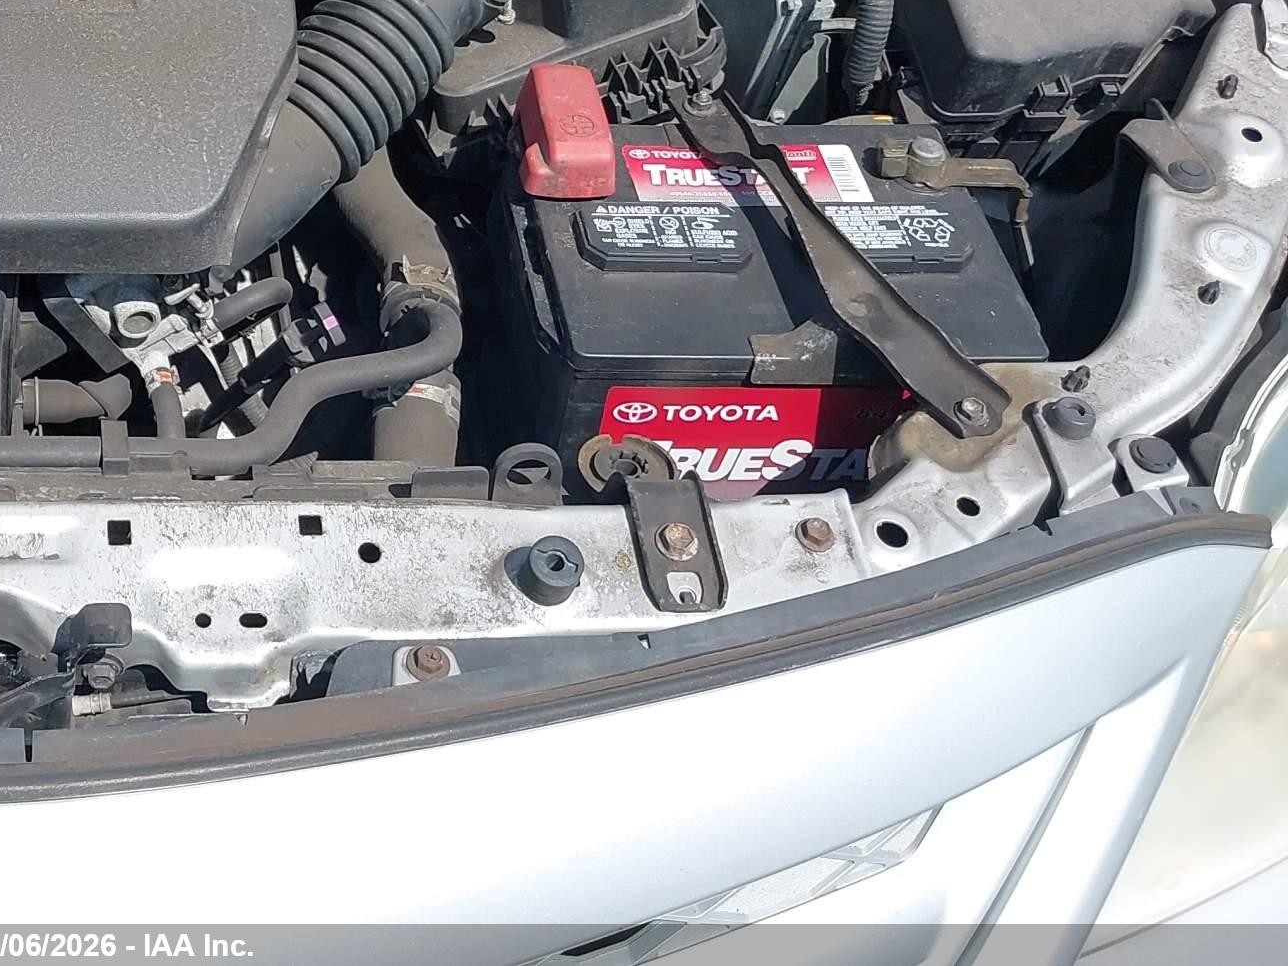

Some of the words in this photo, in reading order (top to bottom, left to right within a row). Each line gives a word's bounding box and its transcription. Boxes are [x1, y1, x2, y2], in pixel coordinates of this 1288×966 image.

[608, 205, 660, 214] DANGER
[673, 206, 719, 215] POISON
[662, 405, 779, 422] TOYOTA
[652, 439, 867, 482] RUESTA
